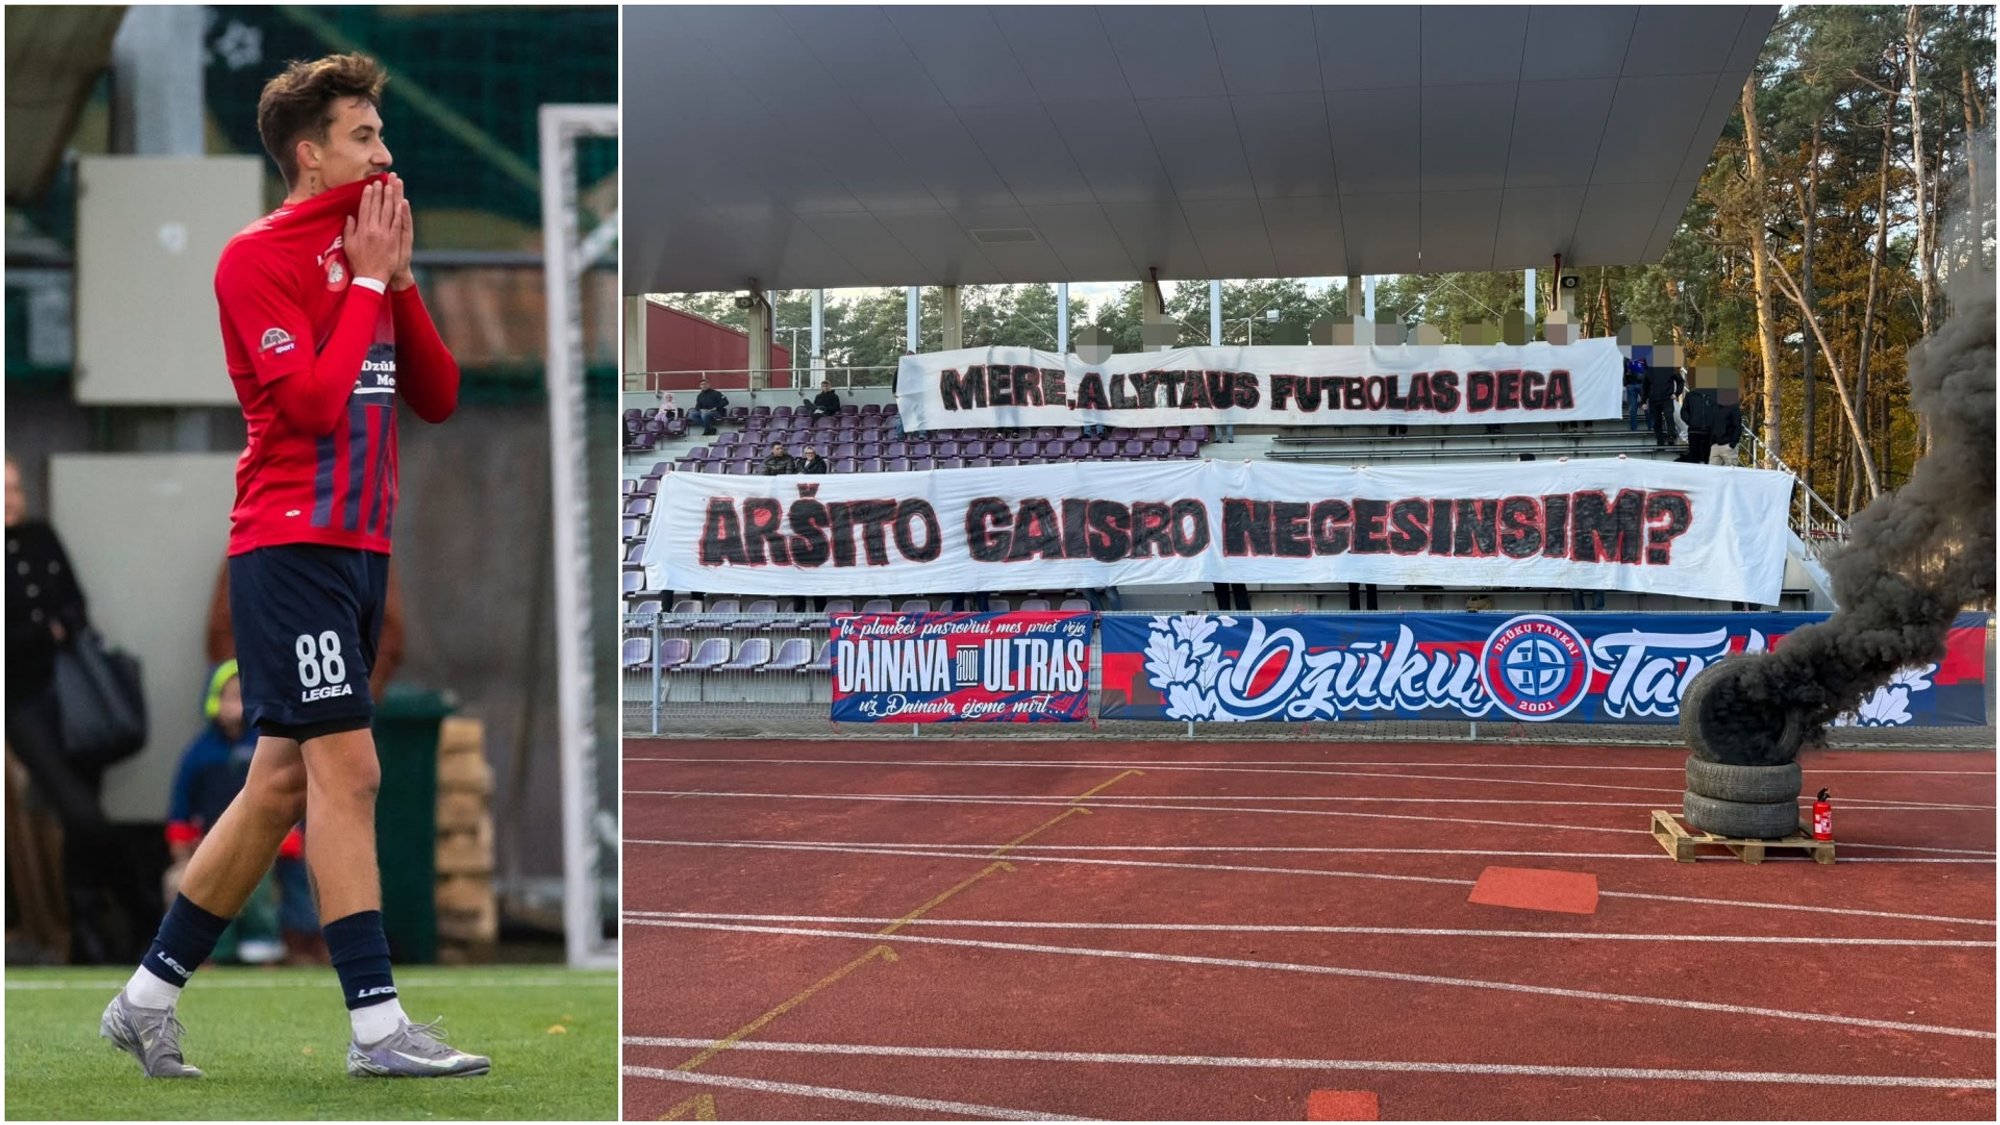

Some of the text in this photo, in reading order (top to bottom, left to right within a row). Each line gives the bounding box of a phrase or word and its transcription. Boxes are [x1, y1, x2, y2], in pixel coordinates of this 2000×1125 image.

[1270, 369, 1460, 412] FUTBOLAS
[1467, 369, 1575, 412] DEGA
[699, 483, 1693, 567] ARŠITO GAISRO NEGESINSIM?
[835, 614, 863, 639] Tu
[859, 616, 917, 640] plaukei
[996, 621, 1023, 634] mes
[1025, 618, 1061, 637] prieš
[1536, 623, 1580, 656] TANKAI
[295, 630, 346, 688] 88
[838, 638, 1085, 693] DAINAVA 2001 ULTRAS
[301, 683, 353, 703] LEGEA
[1518, 701, 1556, 712] 2001
